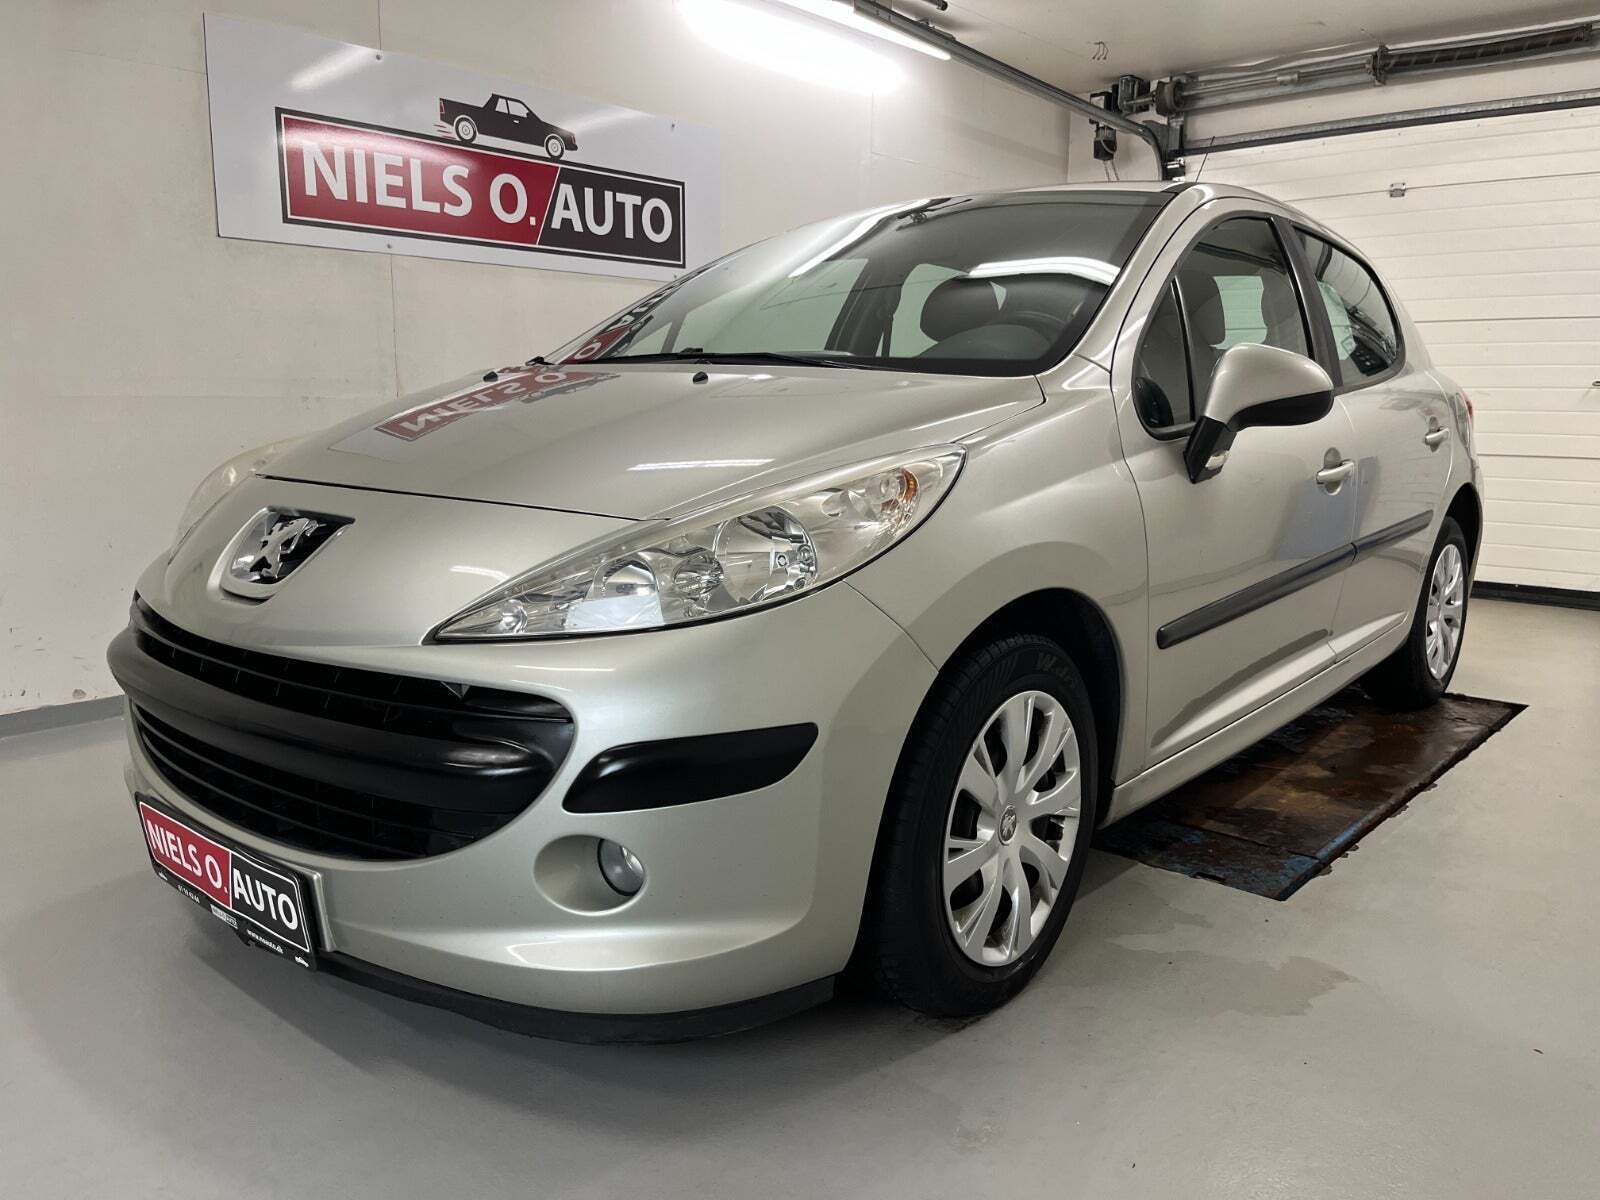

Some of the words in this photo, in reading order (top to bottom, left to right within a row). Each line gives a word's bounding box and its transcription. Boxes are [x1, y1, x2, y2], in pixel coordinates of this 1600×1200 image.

[302, 142, 472, 217] NIELS
[489, 173, 537, 226] O.
[551, 183, 673, 245] AUTO
[146, 819, 203, 877] NIELS
[204, 854, 229, 893] O.
[233, 867, 298, 931] AUTO
